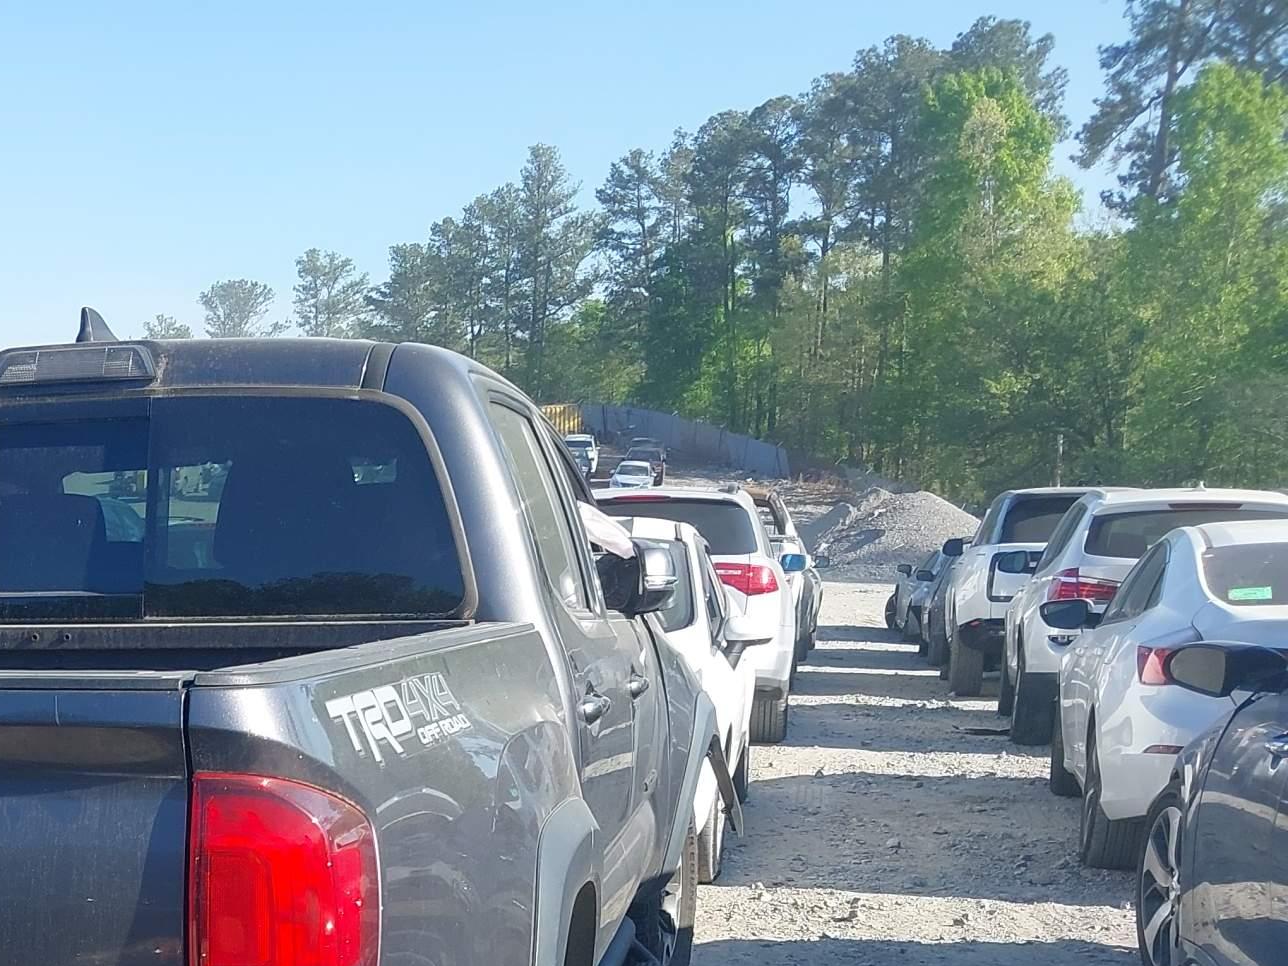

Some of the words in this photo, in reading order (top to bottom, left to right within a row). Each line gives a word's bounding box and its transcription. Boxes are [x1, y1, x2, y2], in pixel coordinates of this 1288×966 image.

[325, 684, 413, 764] TRD
[418, 722, 441, 745] OFF
[439, 713, 472, 737] ROAD
